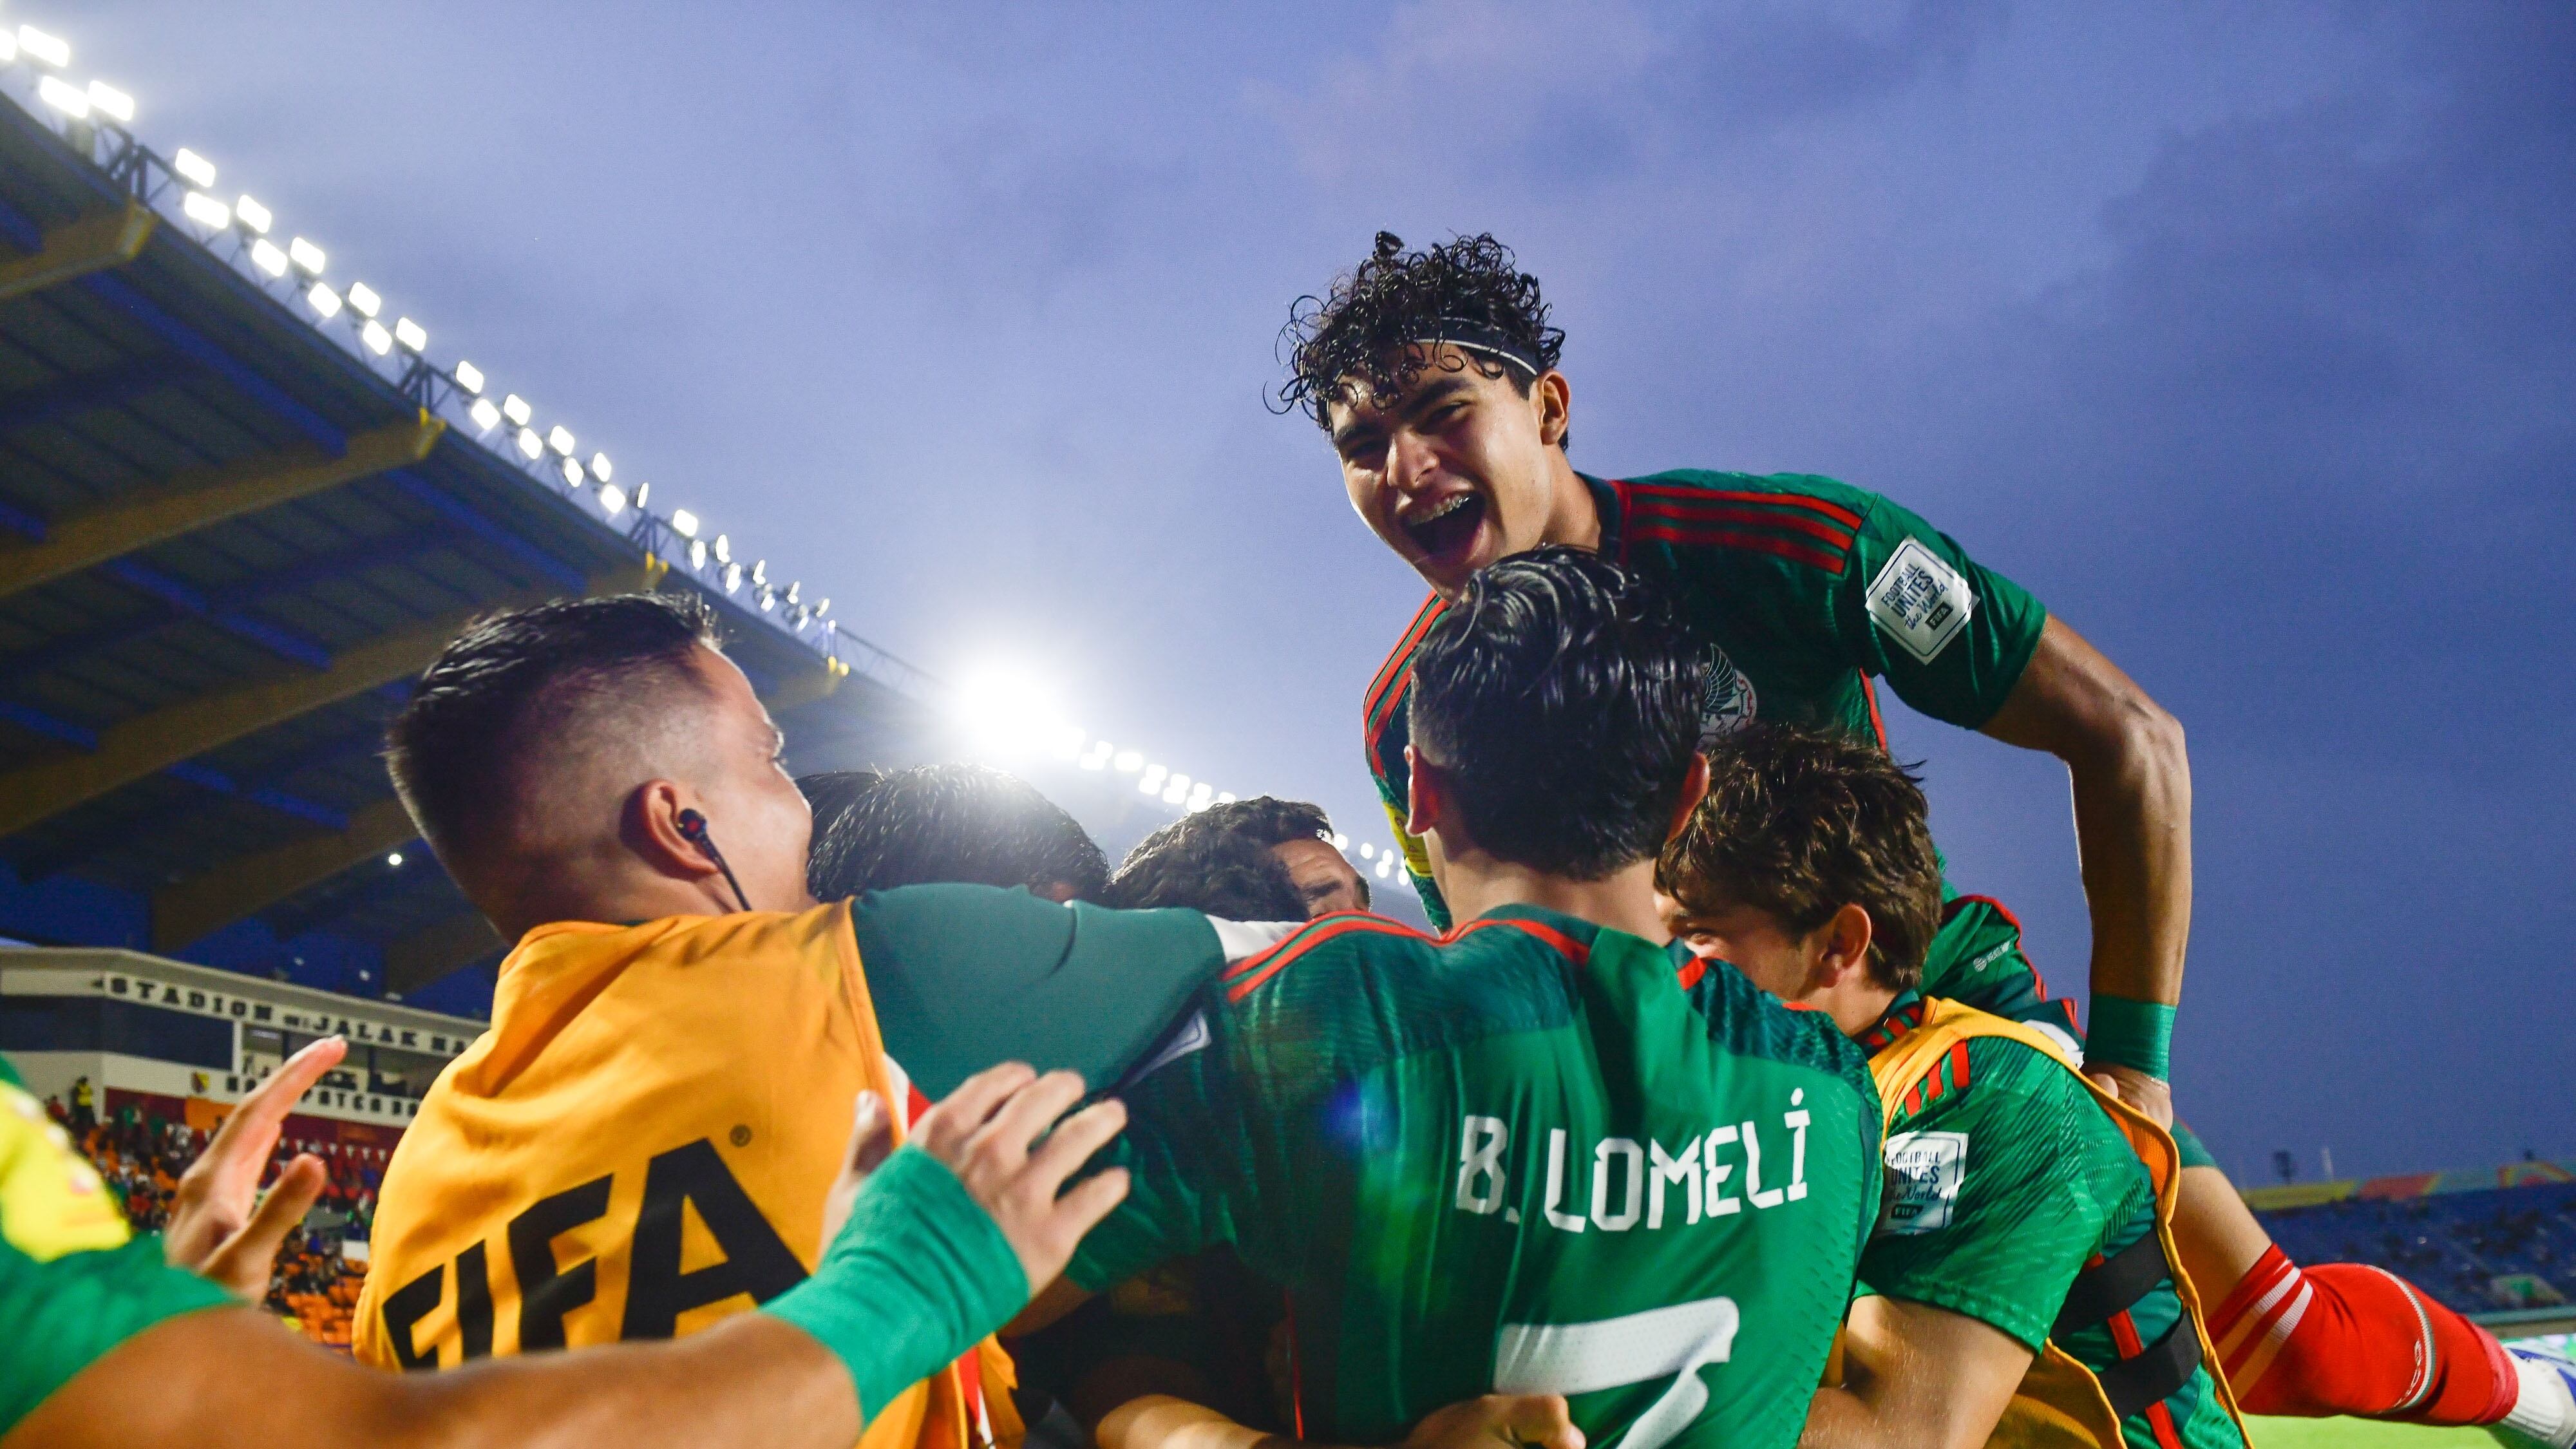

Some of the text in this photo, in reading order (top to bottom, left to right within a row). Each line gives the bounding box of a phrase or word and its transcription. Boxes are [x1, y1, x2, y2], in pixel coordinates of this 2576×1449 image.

[1880, 563, 1920, 607] FOOTBALL
[1891, 570, 1934, 618] UNITES
[1904, 578, 1949, 630] the World
[111, 977, 272, 1020] STADION
[313, 1016, 417, 1047] JALAK
[1456, 1115, 1520, 1224] B.
[382, 1137, 812, 1372] FIFA
